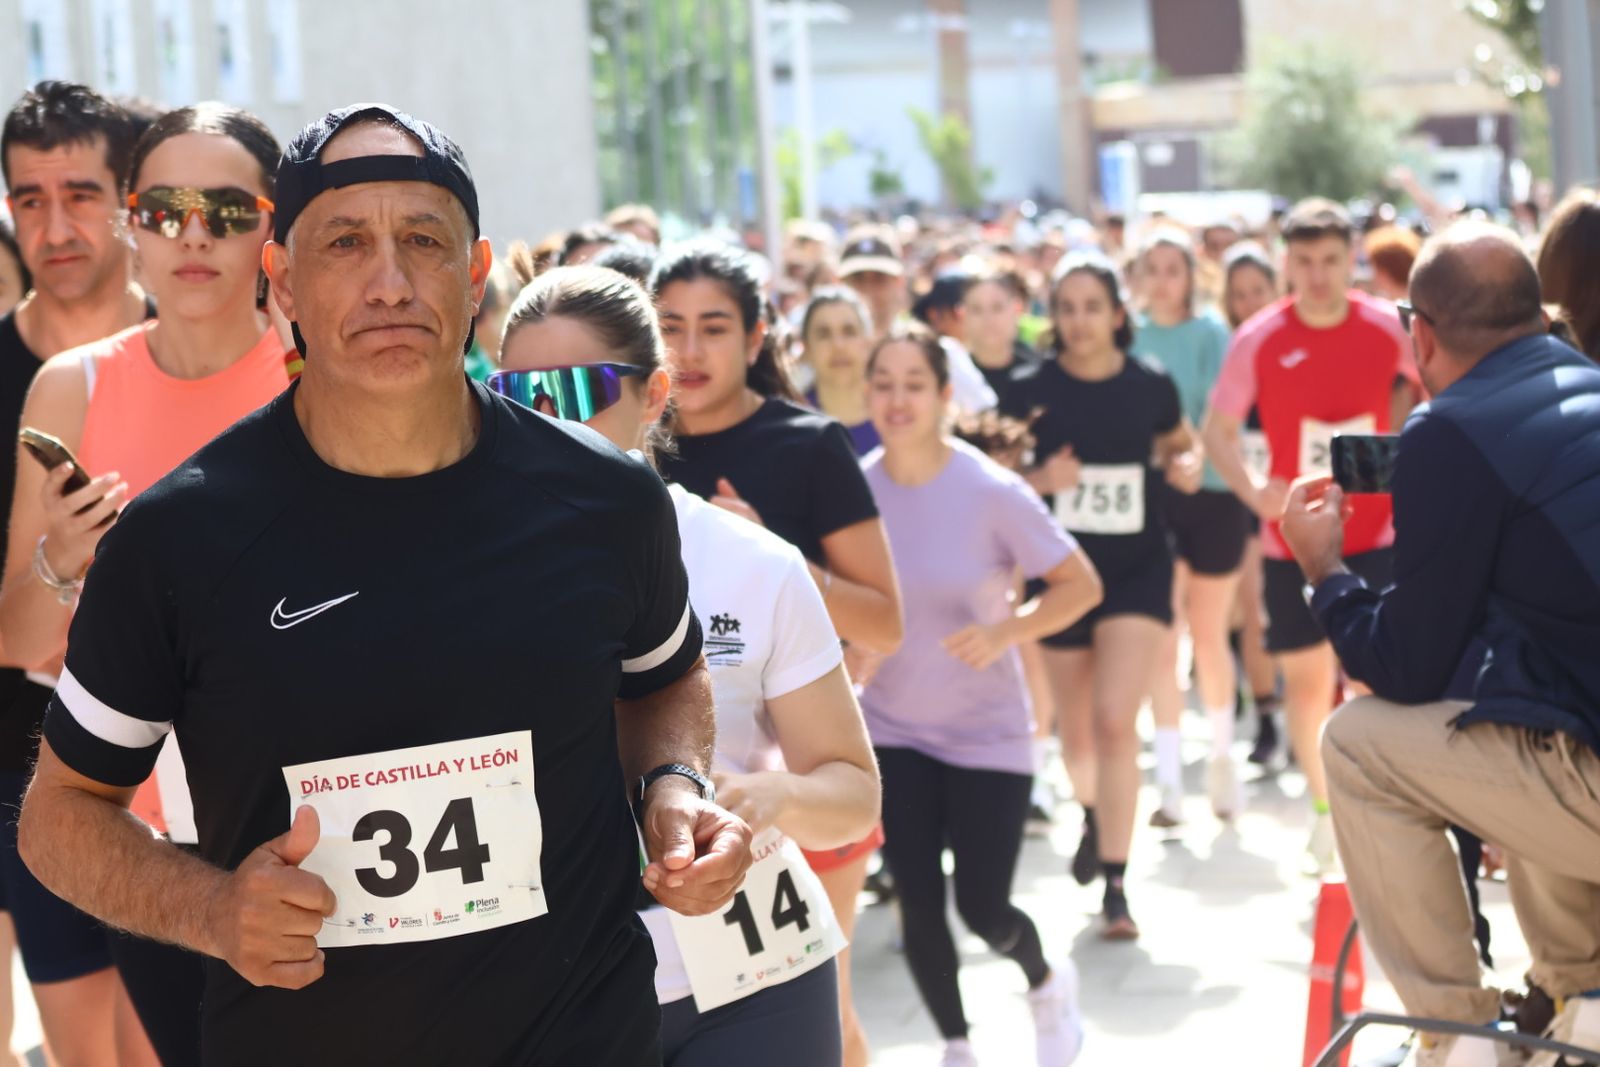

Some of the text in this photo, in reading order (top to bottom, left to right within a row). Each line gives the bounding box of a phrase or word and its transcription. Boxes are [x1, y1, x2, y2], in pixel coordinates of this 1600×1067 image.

[1072, 482, 1132, 515] 758
[300, 748, 519, 795] DÍA DE CASTILLA Y LEÓN
[352, 797, 491, 899] 34
[475, 897, 500, 908] Plena
[723, 868, 810, 957] 14
